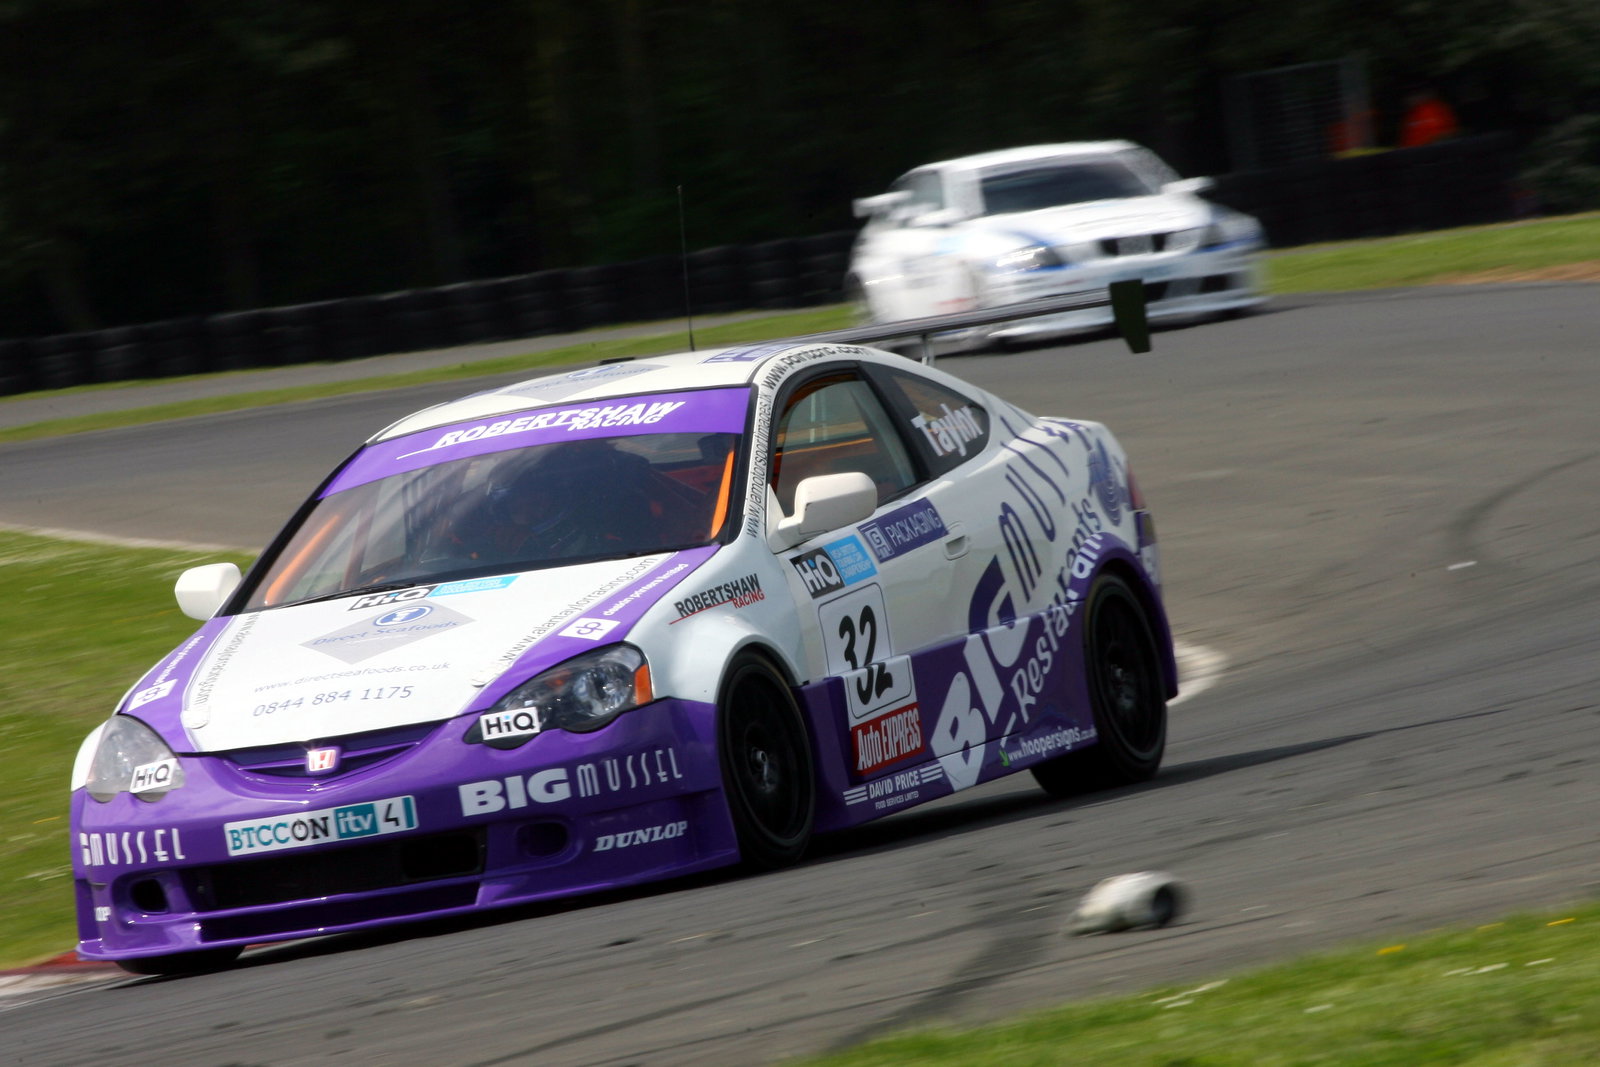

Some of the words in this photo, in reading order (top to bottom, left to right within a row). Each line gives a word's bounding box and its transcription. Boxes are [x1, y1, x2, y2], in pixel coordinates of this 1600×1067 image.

[431, 401, 686, 449] ROBERTSHAW
[568, 414, 663, 431] RACING
[911, 403, 984, 458] Taylor
[884, 508, 942, 548] PACKAGING
[795, 554, 841, 593] HiQ
[353, 588, 434, 609] HiQ
[674, 573, 761, 618] ROBERTSHAW
[732, 588, 765, 609] RACING
[1009, 497, 1102, 724] Restaurants
[312, 630, 369, 647] Direct
[372, 620, 459, 636] Seafoods
[838, 605, 893, 705] 32
[254, 661, 451, 693] www.directseafoods.co.uk
[930, 553, 1032, 793] BIG
[253, 697, 305, 717] 0844
[311, 690, 352, 706] 884
[360, 685, 416, 701] 1175
[484, 712, 536, 736] HiQ
[856, 725, 882, 771] Auto
[880, 708, 922, 761] EXPRESS
[133, 764, 170, 789] HiQ
[458, 768, 572, 817] BIG
[576, 747, 683, 798] MUSSEL
[869, 778, 894, 800] DAVID
[894, 770, 920, 792] PRICE
[337, 811, 373, 834] itv
[383, 803, 400, 827] 4
[592, 821, 688, 852] DUNLOP
